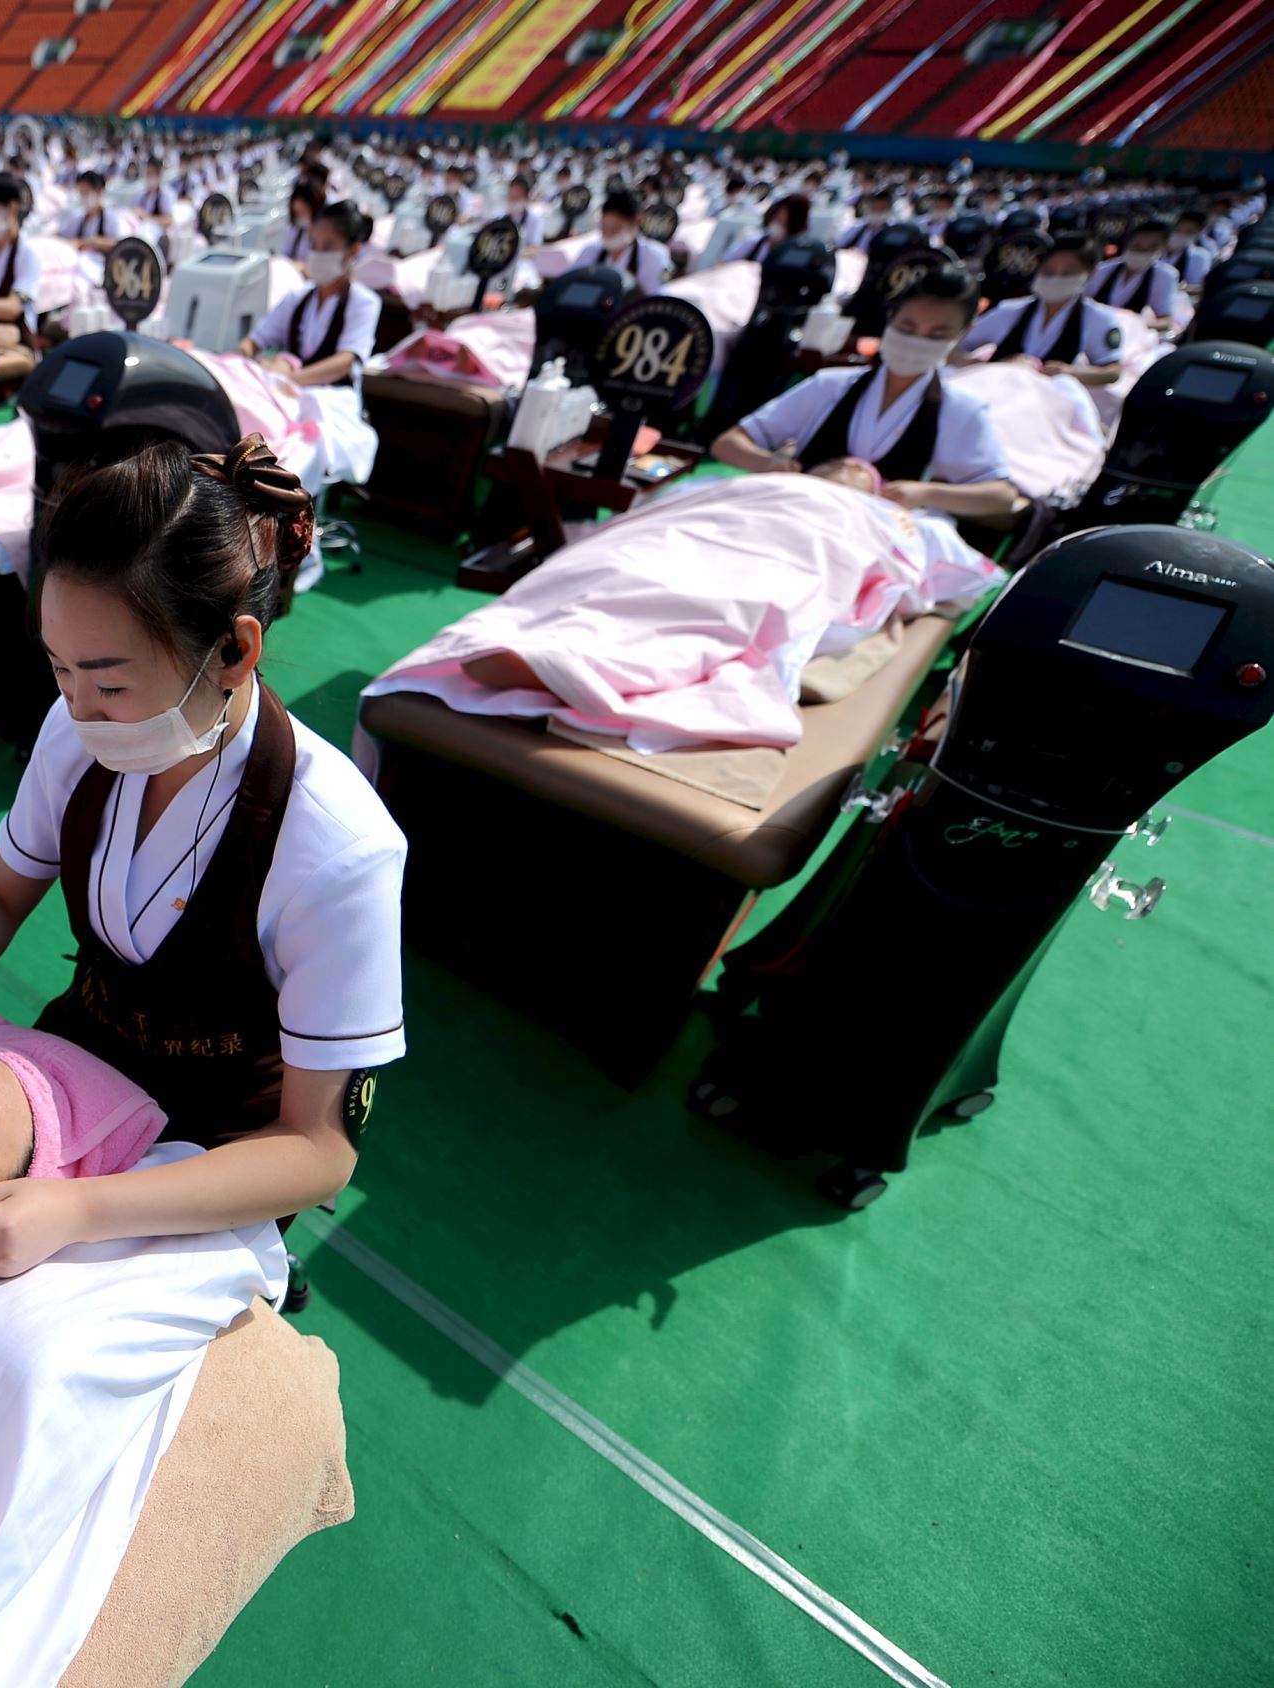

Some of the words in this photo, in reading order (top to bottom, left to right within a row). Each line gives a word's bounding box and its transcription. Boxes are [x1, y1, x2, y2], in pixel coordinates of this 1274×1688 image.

[111, 256, 153, 300] 964
[609, 323, 695, 387] 984
[1143, 560, 1209, 585] Alma
